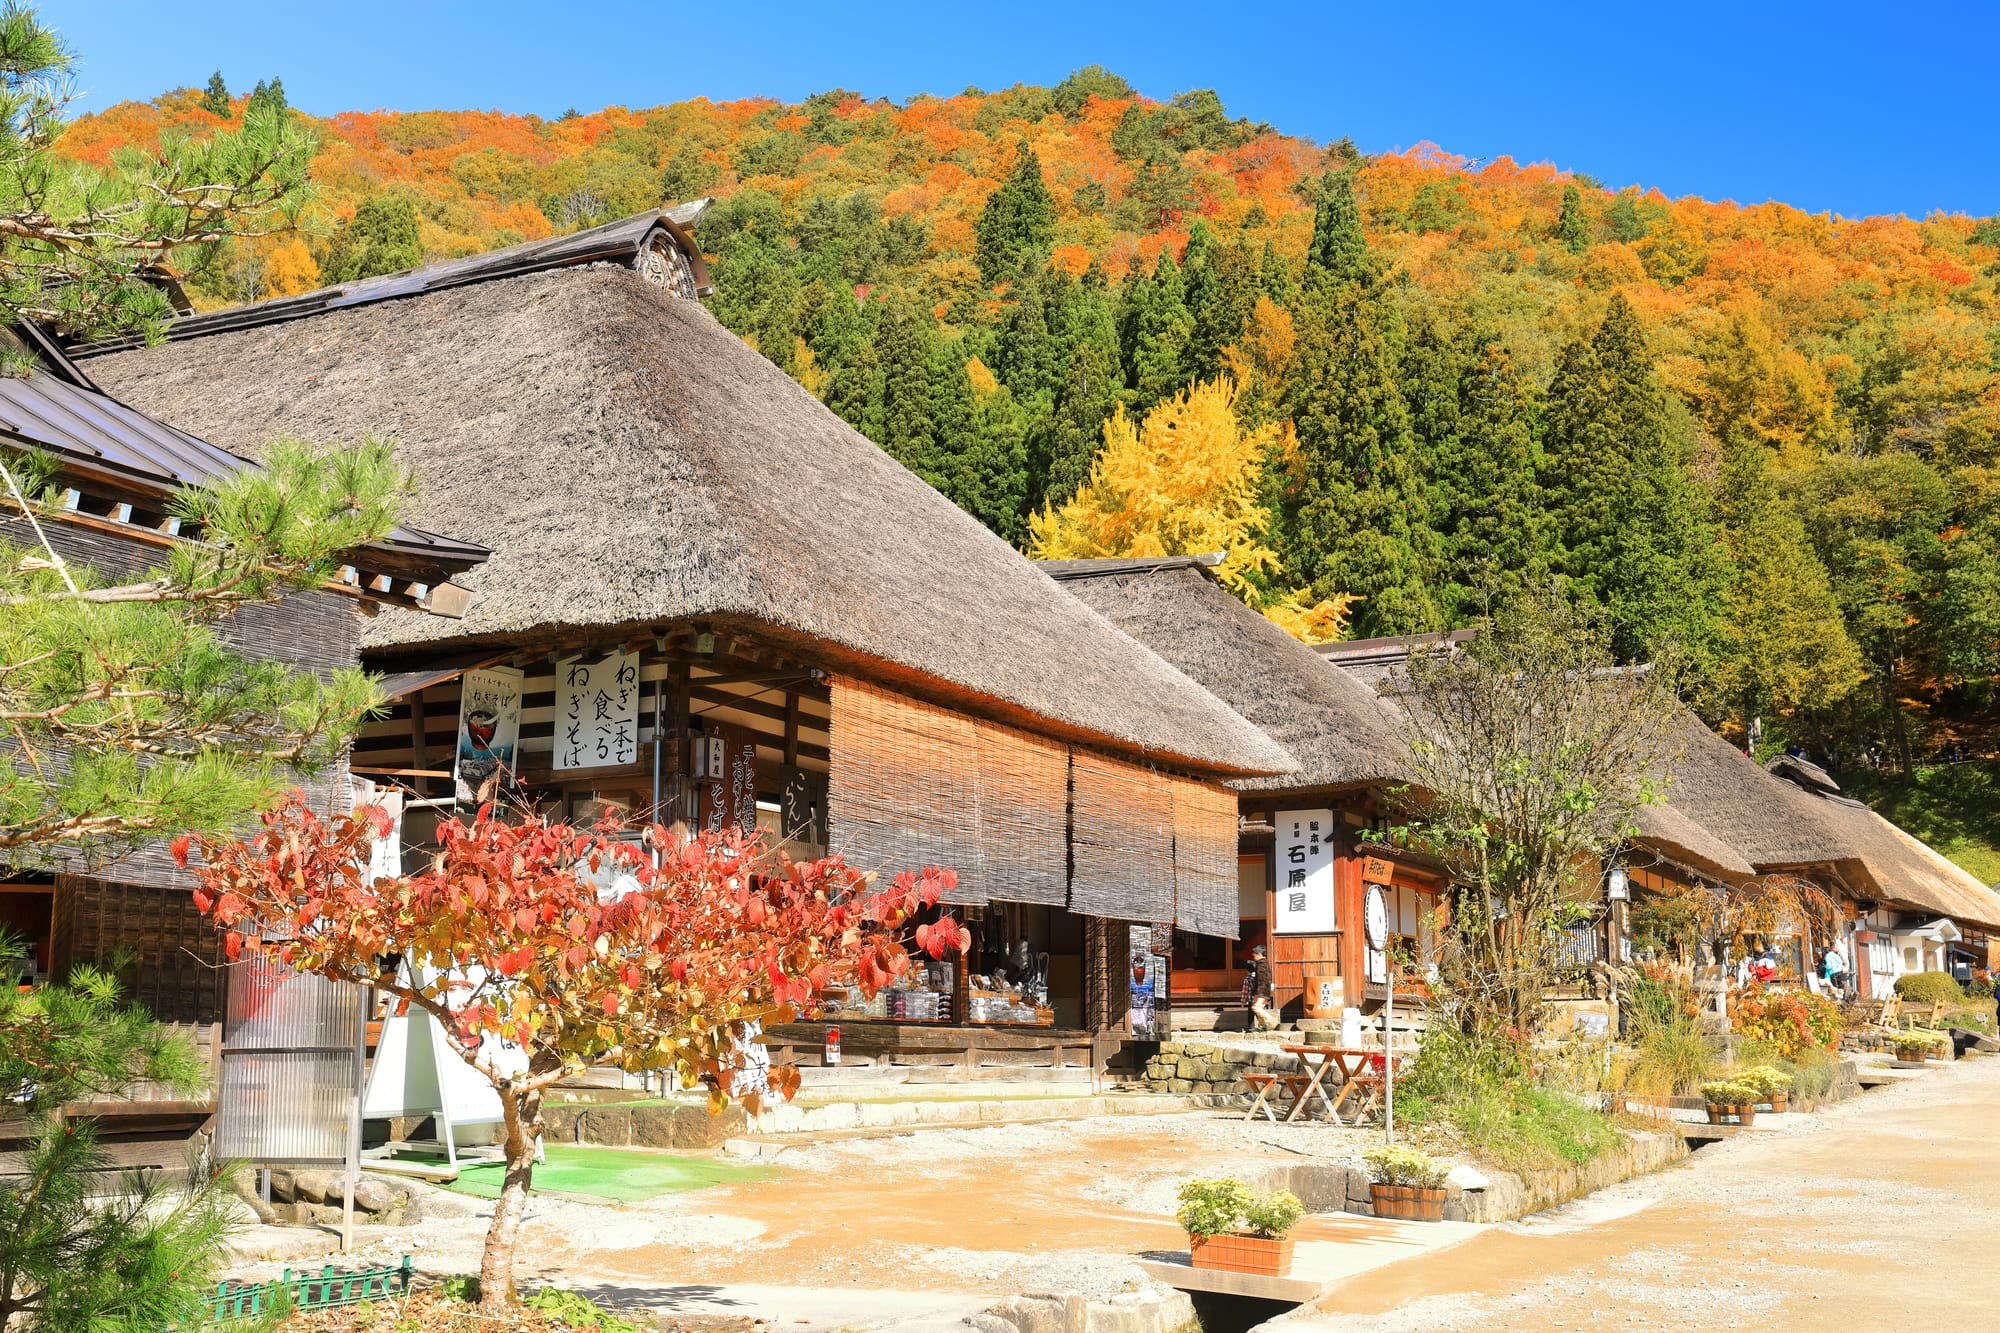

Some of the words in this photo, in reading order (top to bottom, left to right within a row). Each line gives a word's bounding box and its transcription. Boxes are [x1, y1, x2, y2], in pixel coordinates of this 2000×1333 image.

[564, 664, 590, 767] ねぎそば
[592, 688, 615, 760] 食べる
[612, 660, 637, 763] ねぎ一本で
[713, 740, 721, 776] 大和屋
[1287, 845, 1306, 912] 石原屋
